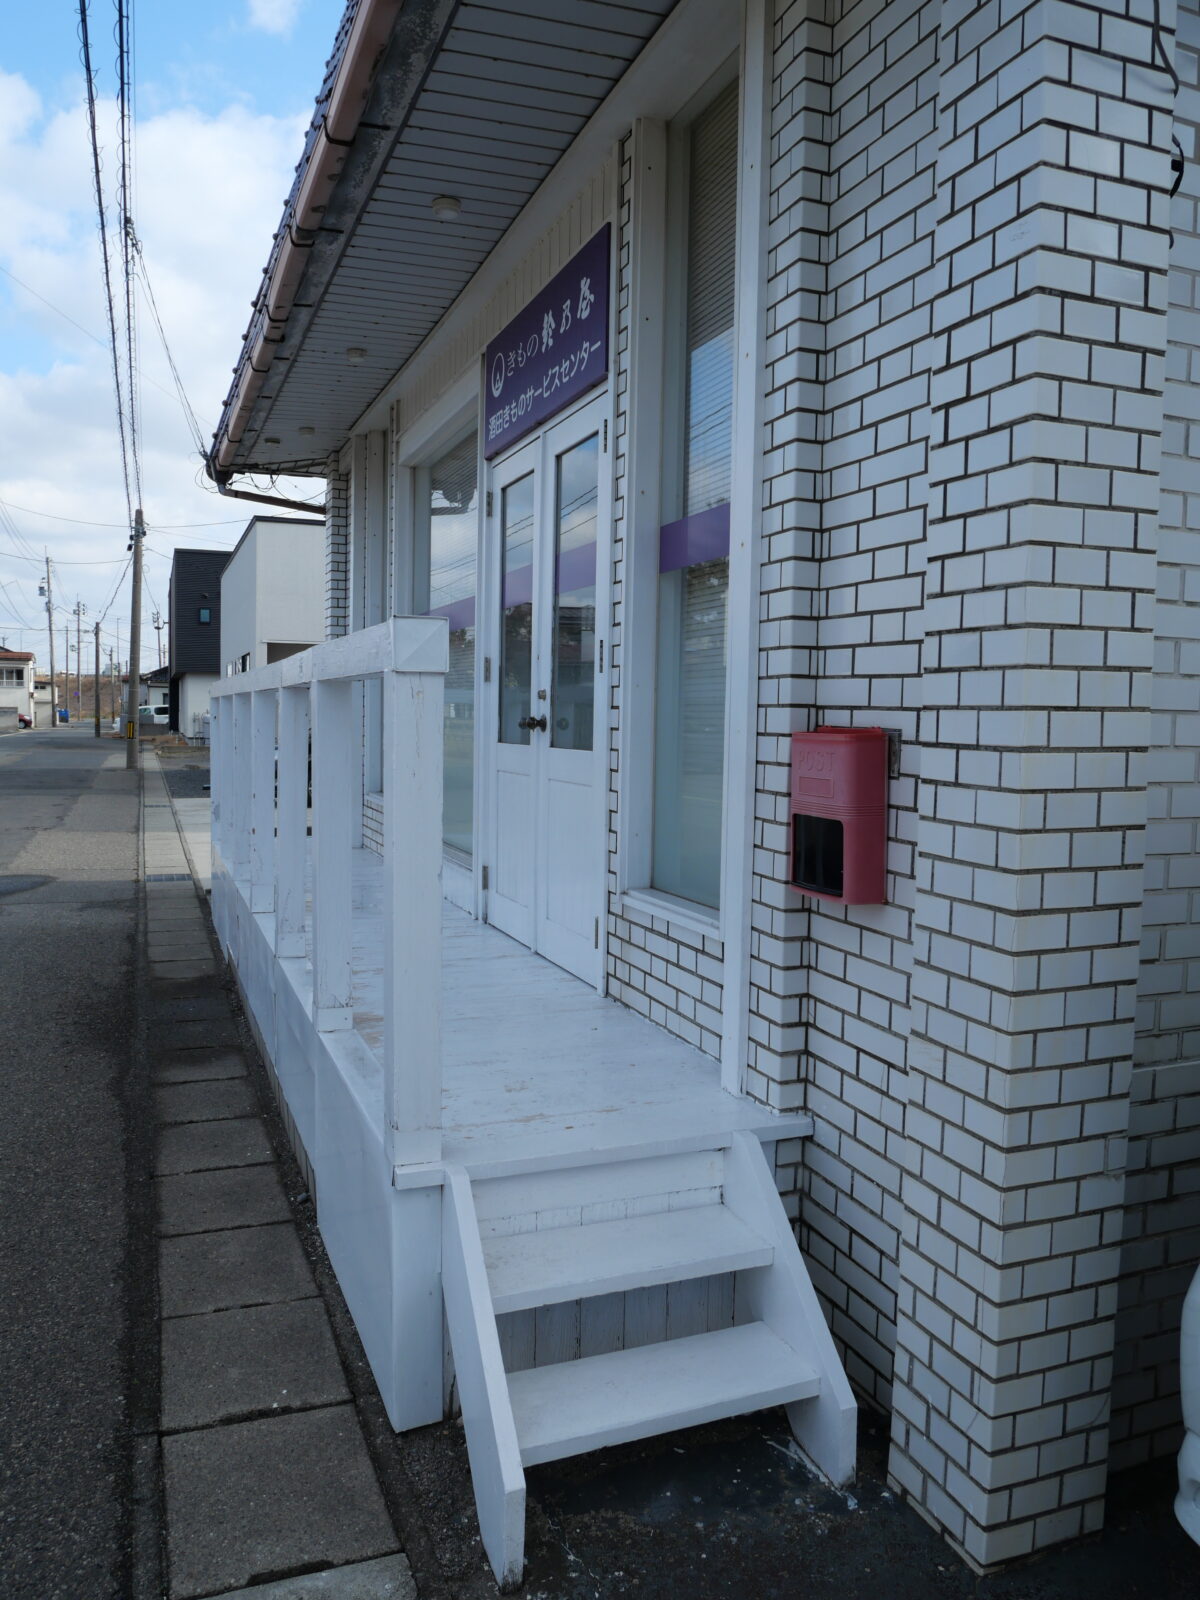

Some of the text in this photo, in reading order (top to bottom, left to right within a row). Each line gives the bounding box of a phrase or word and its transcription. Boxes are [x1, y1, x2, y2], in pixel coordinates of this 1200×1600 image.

[488, 340, 601, 440] 酒田きものサービスセンター
[798, 750, 836, 772] POST
